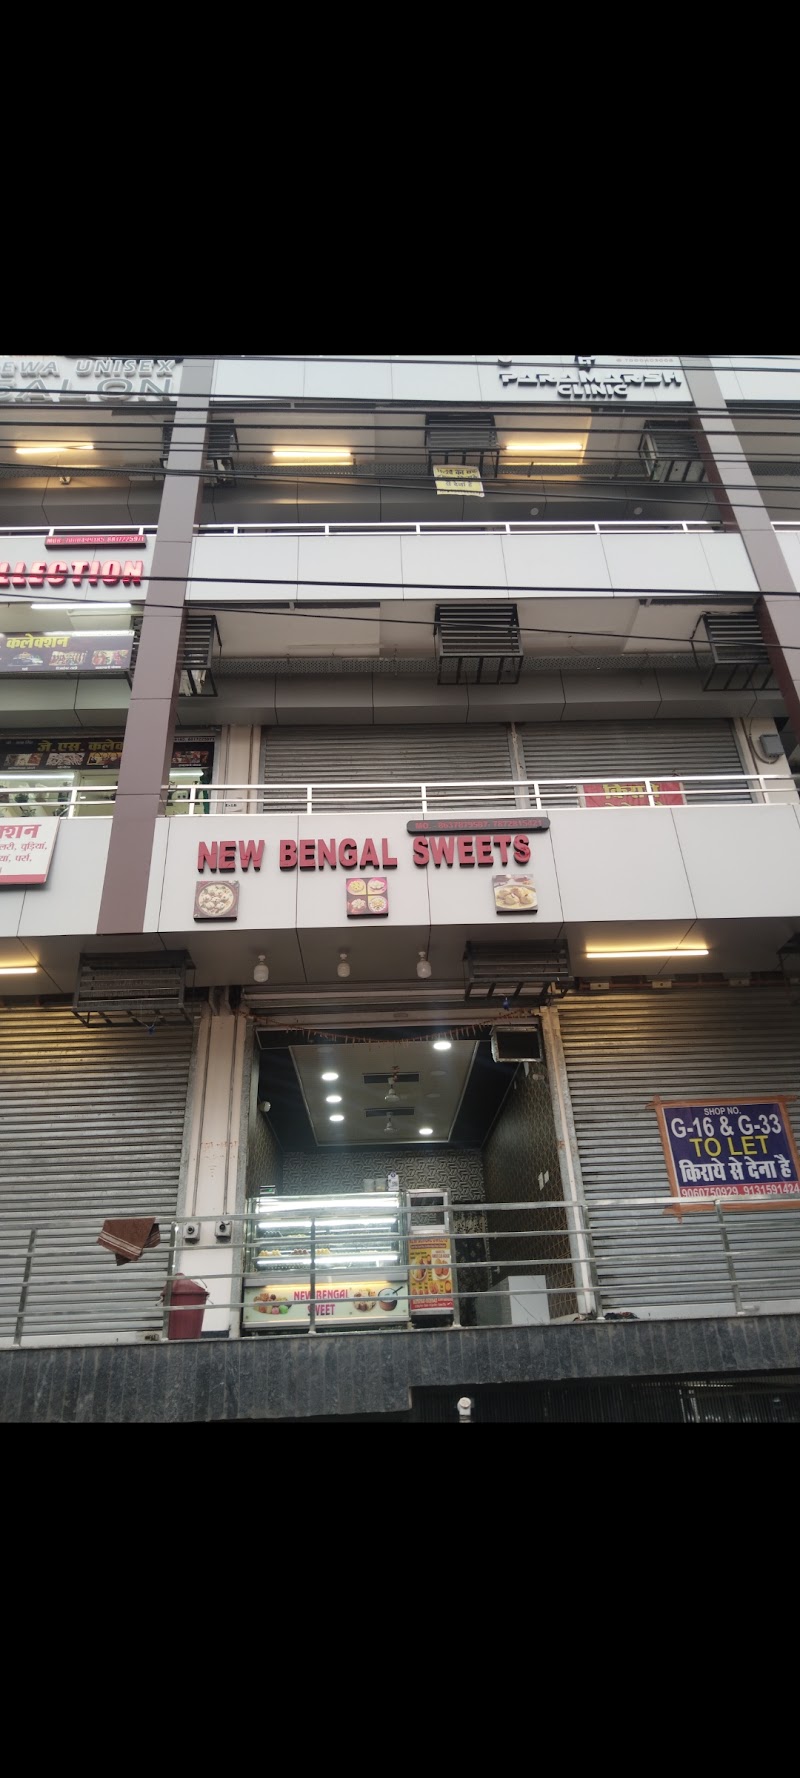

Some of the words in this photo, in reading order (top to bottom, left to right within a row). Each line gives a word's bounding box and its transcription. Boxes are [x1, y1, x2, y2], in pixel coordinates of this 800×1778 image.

[76, 359, 175, 377] UNISEX
[499, 370, 682, 387] PARAMARSH
[0, 378, 173, 402] SALON
[557, 384, 628, 399] CLINIC
[6, 633, 71, 649] कलेक्शन
[197, 840, 265, 873] NEW
[279, 838, 398, 872] BENGAL
[413, 835, 532, 866] SWEETS
[704, 1107, 726, 1116] SHOP
[727, 1106, 742, 1115] NO.
[671, 1117, 715, 1138] G-16
[719, 1116, 734, 1136] &
[738, 1114, 782, 1135] G-33
[689, 1137, 722, 1157] TO
[727, 1135, 769, 1156] LET
[678, 1158, 727, 1182] किराये
[728, 1157, 744, 1180] से
[744, 1156, 777, 1179] देना
[774, 1154, 792, 1178] है
[316, 1289, 348, 1299] BENGAL
